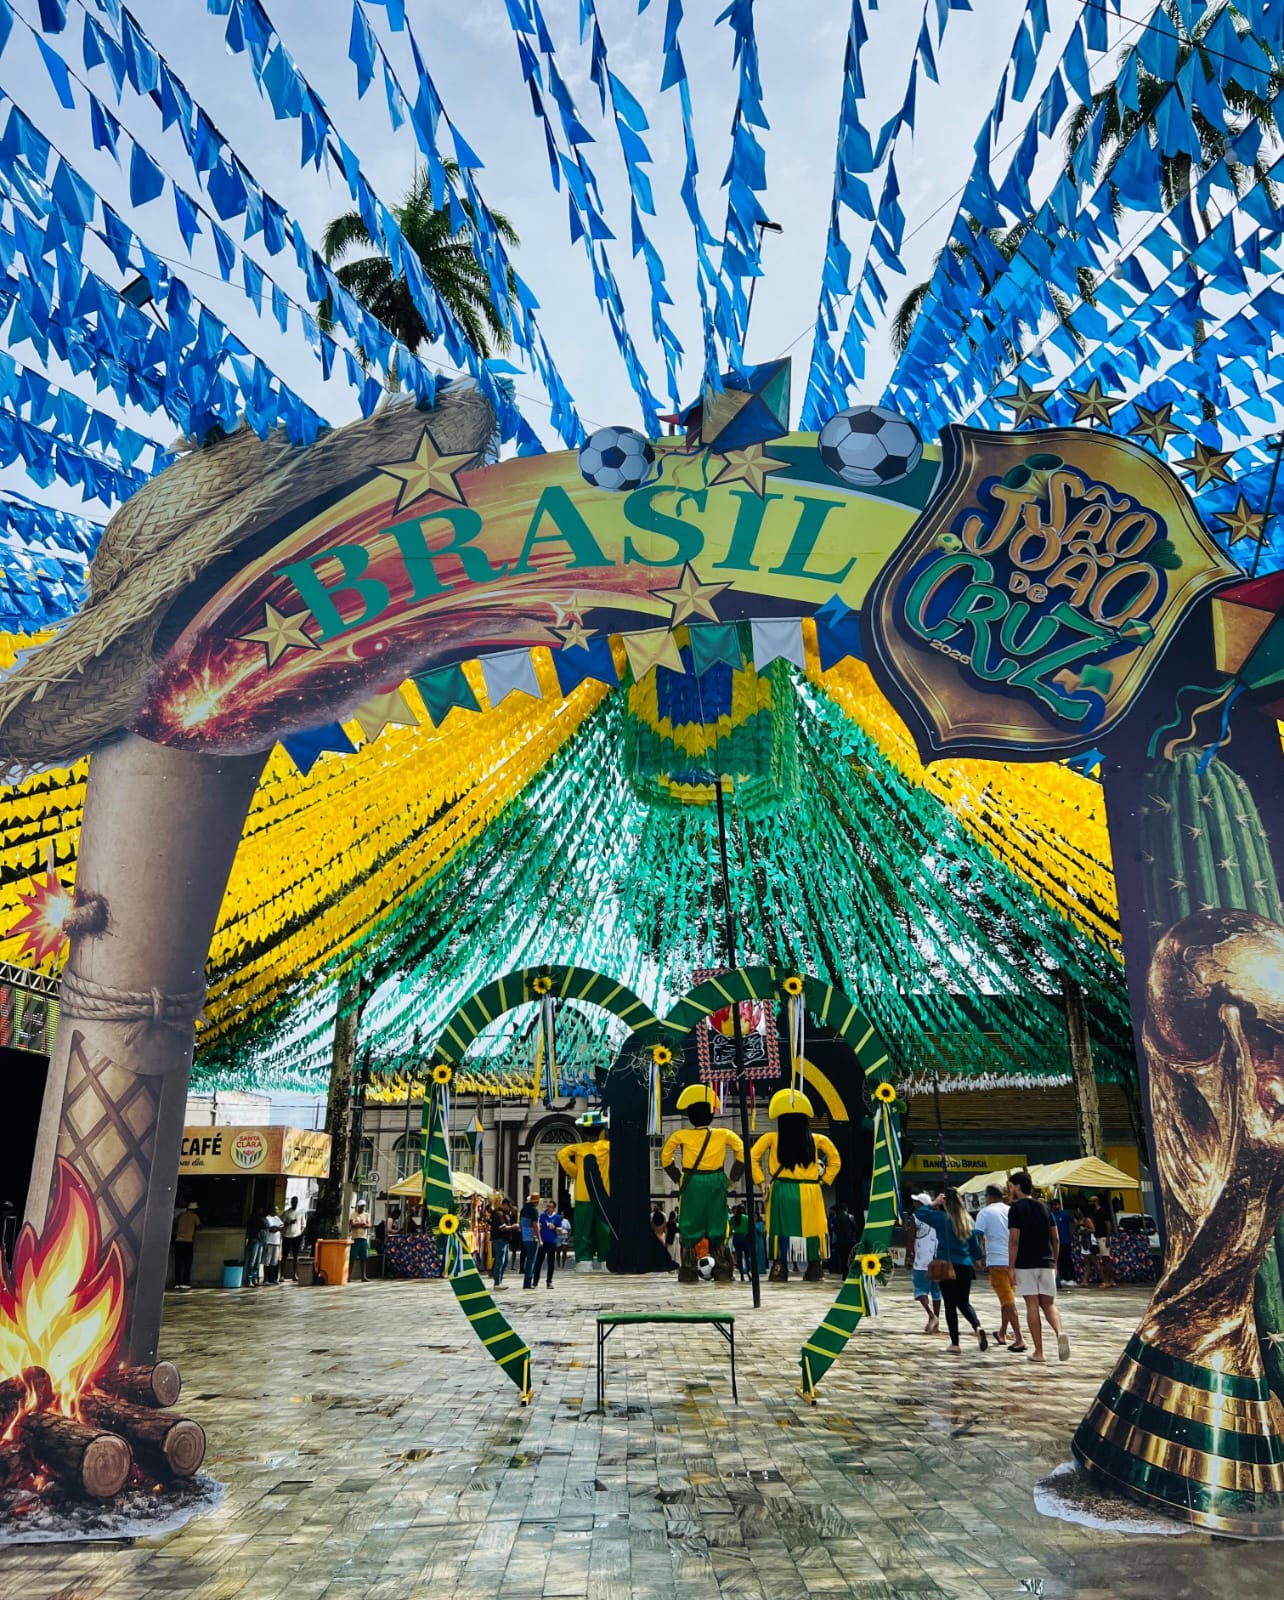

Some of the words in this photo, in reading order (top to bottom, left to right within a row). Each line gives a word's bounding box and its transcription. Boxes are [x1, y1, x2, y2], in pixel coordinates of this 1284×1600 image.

[274, 485, 857, 644] BRASIL
[962, 484, 1159, 627] JOÃO
[1049, 470, 1157, 558] SÃO
[904, 552, 1119, 721] CRUZ
[929, 639, 972, 665] 2026
[180, 1133, 222, 1156] CAFÉ
